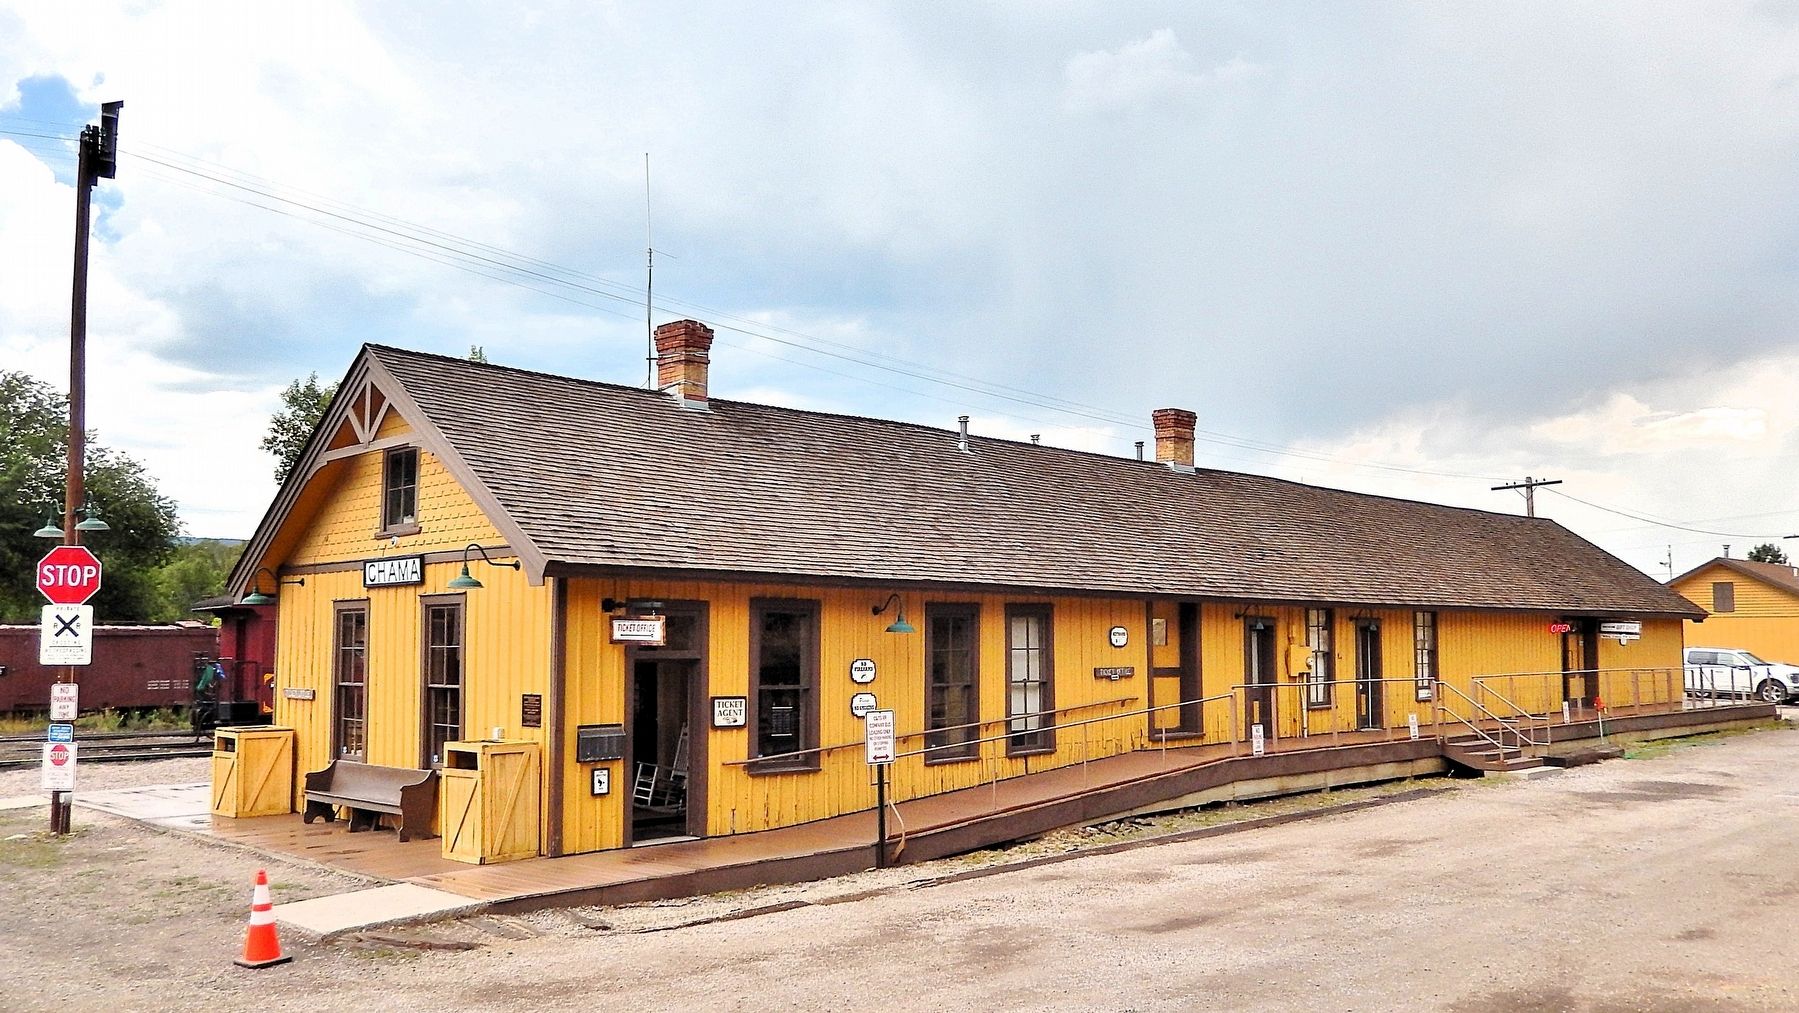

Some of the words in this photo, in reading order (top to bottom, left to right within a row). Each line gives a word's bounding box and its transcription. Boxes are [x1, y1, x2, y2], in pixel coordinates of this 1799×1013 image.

[41, 564, 97, 587] STOP
[368, 560, 420, 583] CHAMA
[53, 622, 59, 630] R
[76, 622, 81, 630] R
[617, 624, 636, 632] TICKET
[637, 623, 656, 632] OFFICE
[1550, 624, 1571, 633] OPEN
[717, 701, 743, 709] TICKET
[717, 709, 743, 717] AGENT
[50, 752, 68, 760] STOP
